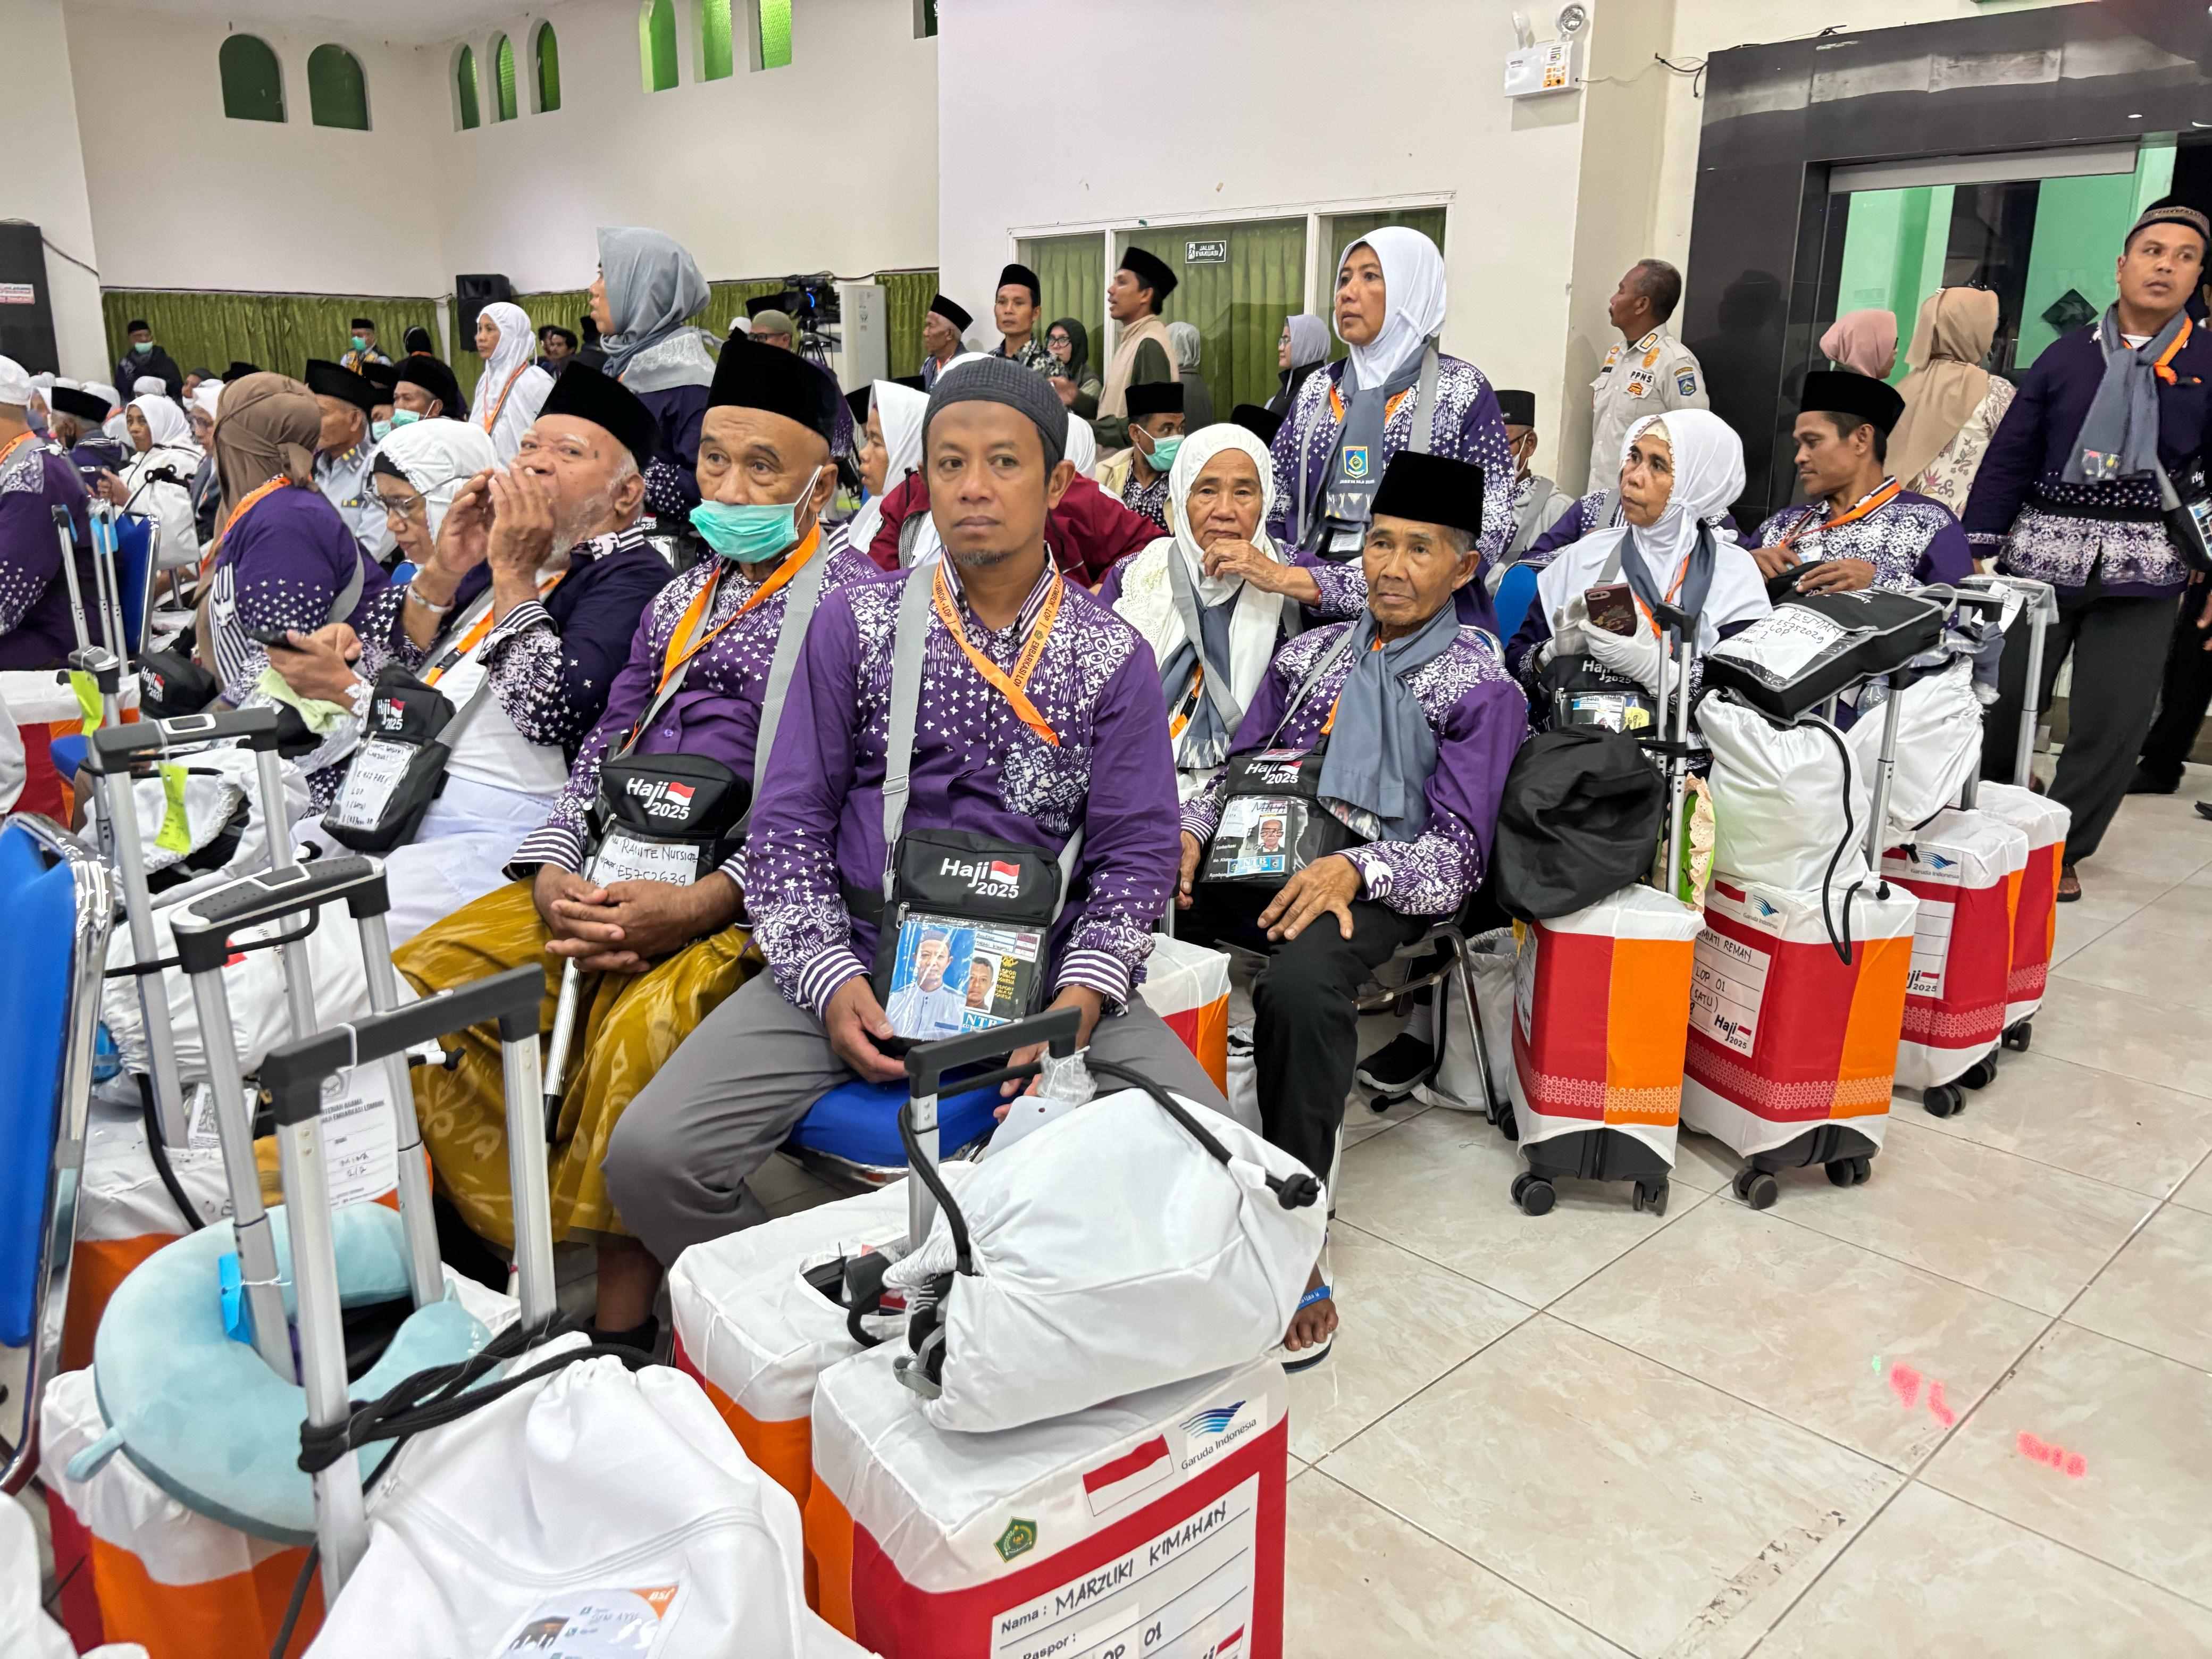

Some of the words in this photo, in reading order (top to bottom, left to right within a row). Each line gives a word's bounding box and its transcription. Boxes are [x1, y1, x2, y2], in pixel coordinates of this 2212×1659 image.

[1630, 371, 1652, 383] PPNS
[942, 605, 953, 618] LOP
[1043, 608, 1052, 622] LOP
[1018, 641, 1040, 675] EMBARKASI
[1605, 675, 1632, 684] 2025
[385, 718, 404, 731] 2025
[1244, 763, 1280, 781] Haji
[1266, 773, 1299, 785] 2025
[626, 777, 669, 808] Haji
[648, 801, 691, 820] 2025
[1243, 857, 1268, 867] NTB
[940, 858, 990, 887] Haji
[975, 882, 1020, 899] 2025
[1723, 940, 1753, 963] REMAN
[1696, 966, 1711, 982] LOP
[1715, 978, 1725, 993] 01
[1906, 969, 1921, 989] ji
[1913, 984, 1938, 992] 2025
[1714, 1013, 1738, 1041] Haji
[1729, 1036, 1748, 1049] 2025
[1181, 1445, 1214, 1470] Garuda
[1215, 1419, 1257, 1450] Indonesia
[1149, 1501, 1227, 1566] KIMAHAN
[1001, 1610, 1040, 1635] Nama
[1144, 1621, 1162, 1647] 01
